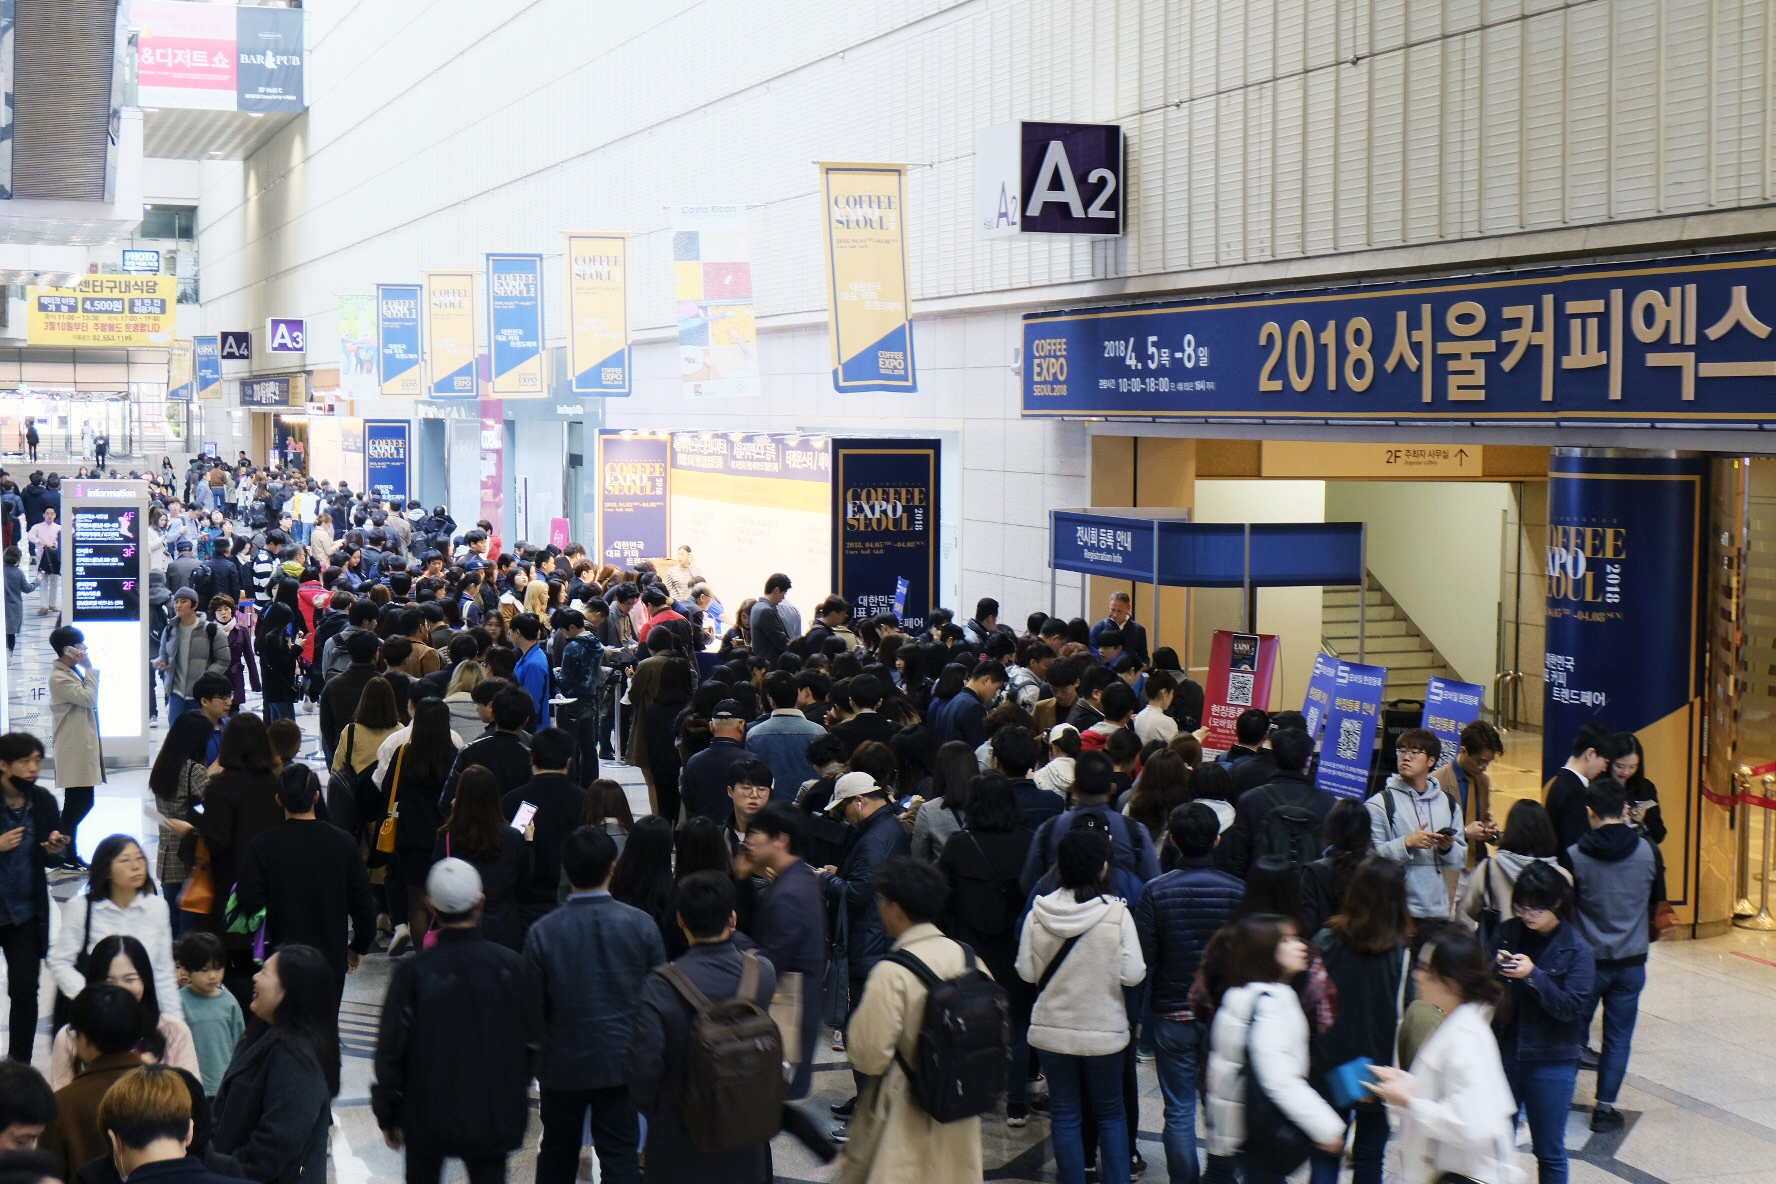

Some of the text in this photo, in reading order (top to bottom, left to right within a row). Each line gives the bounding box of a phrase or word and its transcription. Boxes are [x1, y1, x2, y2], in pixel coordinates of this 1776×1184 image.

[210, 51, 230, 68] 쇼
[1025, 140, 1116, 219] A2
[682, 205, 737, 214] Costa Rican
[834, 195, 897, 210] COFFEE
[996, 181, 1017, 229] A2
[835, 215, 888, 230] SEOUL
[125, 252, 158, 261] PHOTO
[574, 255, 622, 266] COFFEE
[84, 300, 123, 312] 4,500원
[272, 323, 303, 348] A3
[223, 335, 248, 356] A4
[1033, 338, 1067, 356] COFFEE
[1103, 341, 1125, 358] 2018
[1259, 284, 1776, 403] 2018 서울커피엑스
[878, 351, 904, 359] COFFEE
[878, 359, 904, 369] EXPO
[1033, 358, 1067, 381] EXPO
[602, 373, 623, 381] EXPO
[1033, 384, 1067, 396] SEOUL 2018
[1386, 449, 1449, 463] 2F 주최자 사무실
[605, 462, 665, 477] COFFEE
[605, 472, 648, 486] EXPO
[87, 488, 136, 497] information
[605, 481, 655, 495] SEOUL
[846, 487, 926, 506] COFFEE
[846, 499, 903, 518] EXPO
[846, 513, 913, 531] SEOUL
[914, 508, 923, 531] 2018
[614, 540, 644, 550] 대한민국
[1076, 525, 1132, 552] 전시회 등록 안내
[122, 548, 135, 557] 3F
[605, 549, 639, 558] 대표 커피
[1083, 548, 1123, 564] Registration Info
[122, 581, 135, 591] 2F
[1605, 563, 1622, 604] 2018
[858, 595, 896, 607] 대한민국
[1550, 670, 1567, 688] 커피
[30, 687, 46, 701] 1F
[1552, 686, 1606, 708] 트렌드페어
